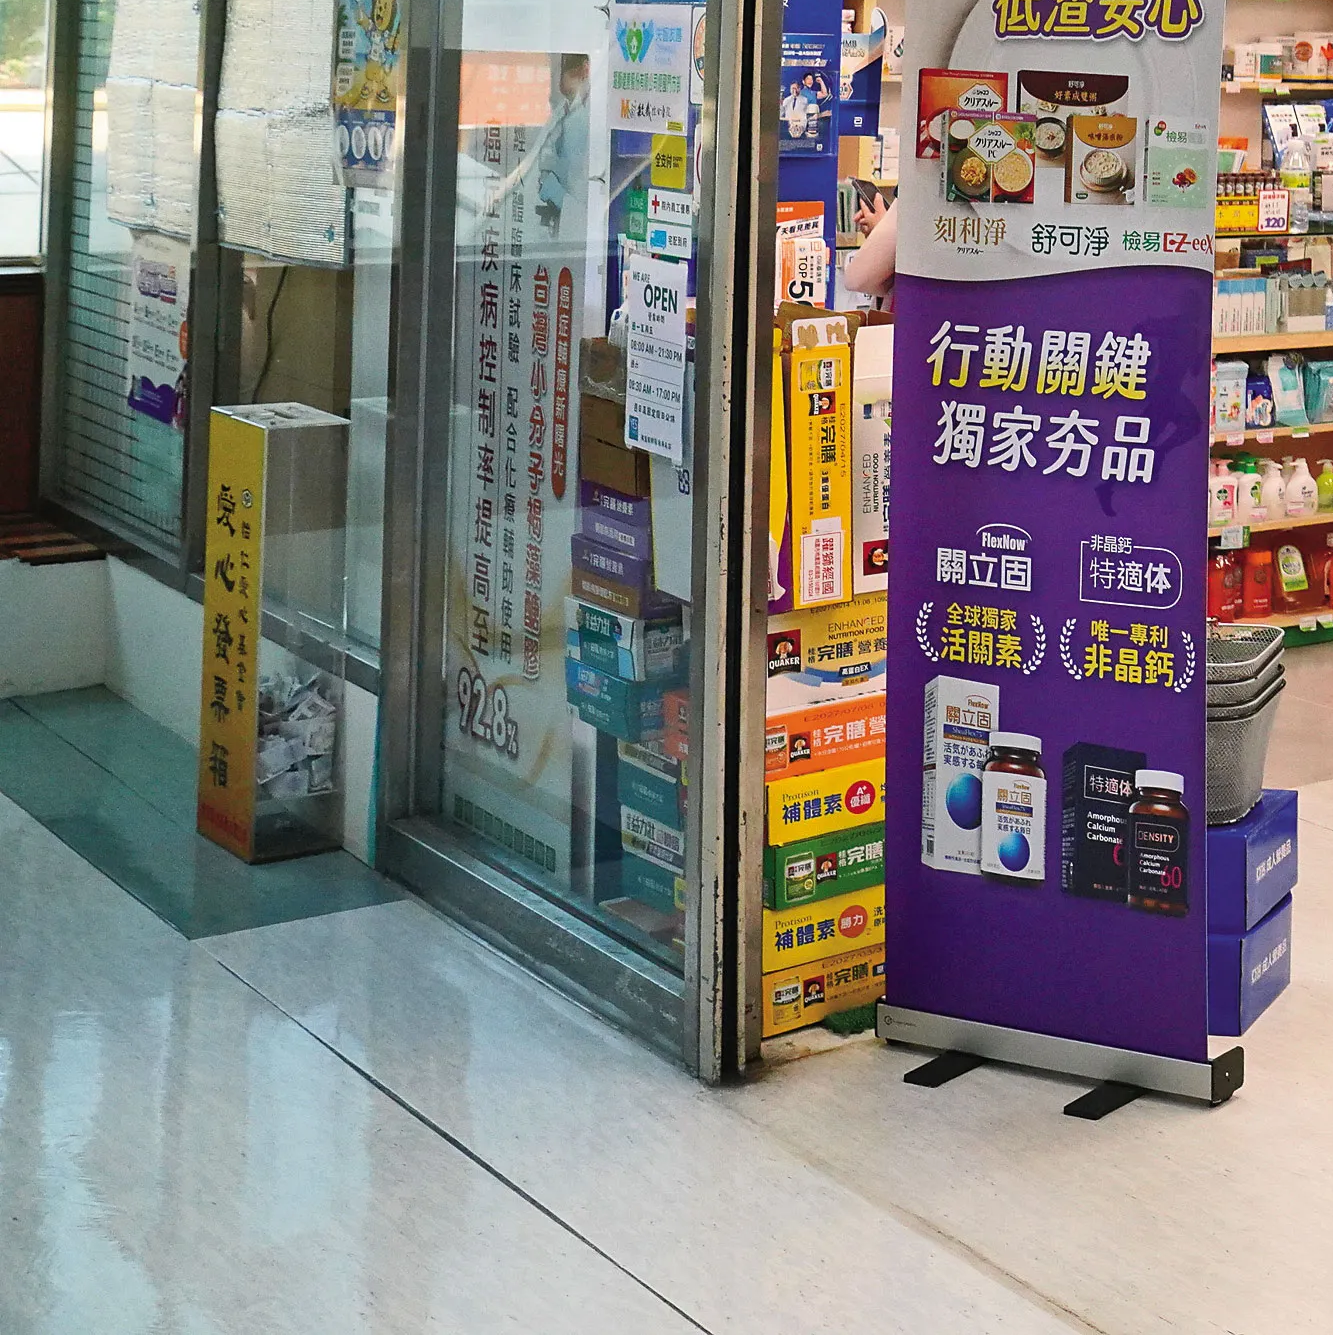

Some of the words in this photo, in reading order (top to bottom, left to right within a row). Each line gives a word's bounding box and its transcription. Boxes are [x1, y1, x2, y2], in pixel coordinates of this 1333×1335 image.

[934, 216, 1007, 246] 刻利淨
[1264, 217, 1286, 229] 120
[1031, 223, 1110, 258] 舒可淨
[1122, 230, 1161, 253] 檢易
[632, 270, 641, 281] WE
[641, 272, 651, 283] ARE
[798, 256, 808, 279] TOP
[643, 285, 678, 315] OPEN
[645, 343, 655, 356] AM
[673, 350, 683, 363] PM
[926, 319, 1152, 401] 行動關鍵
[642, 383, 652, 395] AM
[669, 390, 681, 404] PM
[932, 400, 1156, 484] 獨家夯品
[872, 452, 880, 473] FOOD
[981, 531, 1027, 553] FlexNow
[1089, 535, 1133, 555] 非晶鈣
[936, 547, 1033, 593] 關立固
[1088, 559, 1173, 595] 特適体
[827, 615, 885, 633] ENHANCED
[946, 602, 1018, 629] 全球獨家
[828, 629, 865, 641] NUTRITION
[865, 625, 885, 637] FOOD
[1090, 619, 1169, 650] 唯一專利
[816, 641, 854, 663] 完膳
[939, 626, 1024, 670] 活關素
[768, 656, 801, 670] QUAKER
[1083, 643, 1175, 689] 非晶鈣
[456, 666, 519, 761] 92.8%
[823, 722, 866, 746] 完膳
[782, 793, 842, 825] 補體素
[1086, 821, 1116, 834] Calcium
[1138, 829, 1175, 844] DENSITY
[847, 841, 884, 866] 完膳
[1139, 859, 1161, 868] Calcium
[774, 918, 836, 953] 補體素
[834, 962, 869, 986] 完膳
